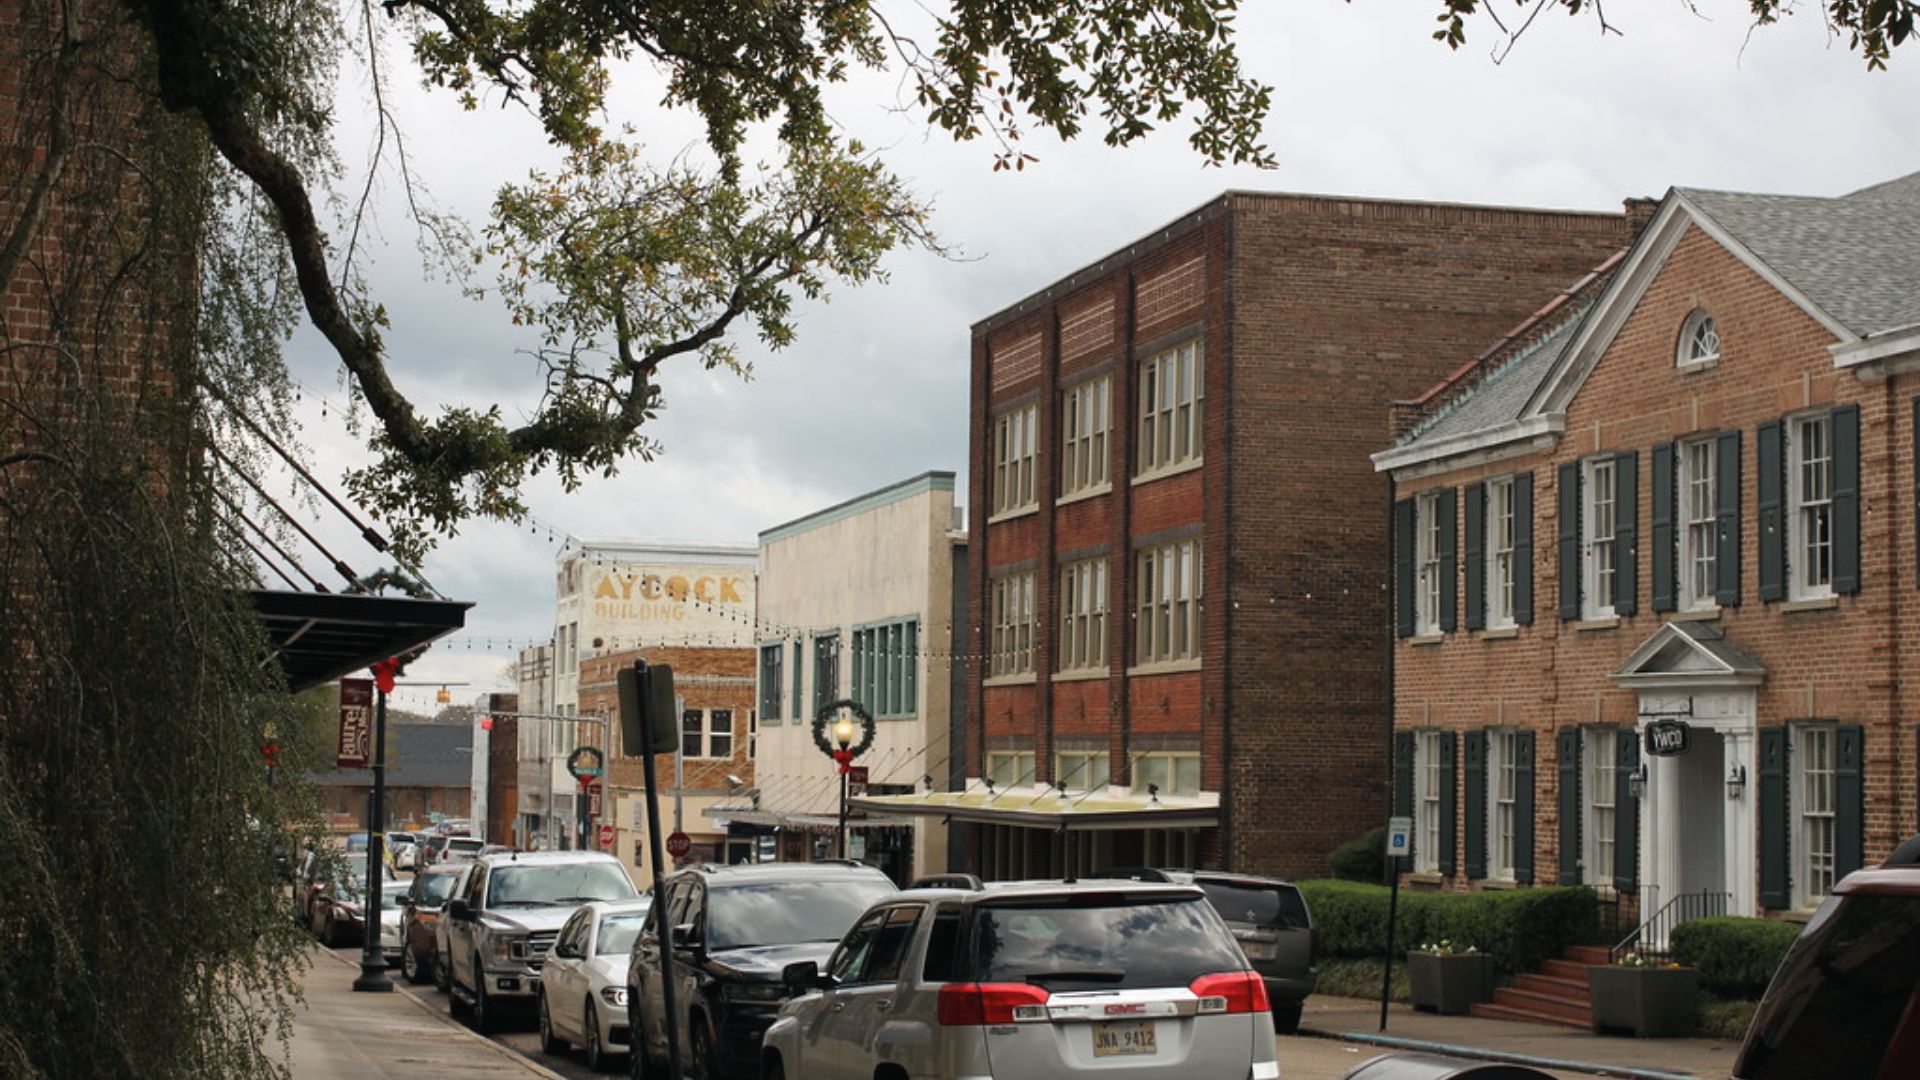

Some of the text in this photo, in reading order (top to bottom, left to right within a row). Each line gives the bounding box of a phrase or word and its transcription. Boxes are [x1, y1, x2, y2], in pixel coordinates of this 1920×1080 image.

[595, 574, 741, 603] AYCOCK
[595, 603, 684, 620] BUILDING
[339, 704, 362, 760] Laurel
[668, 839, 688, 850] STOP
[1104, 1003, 1146, 1015] GMC
[1124, 1030, 1155, 1047] 9412
